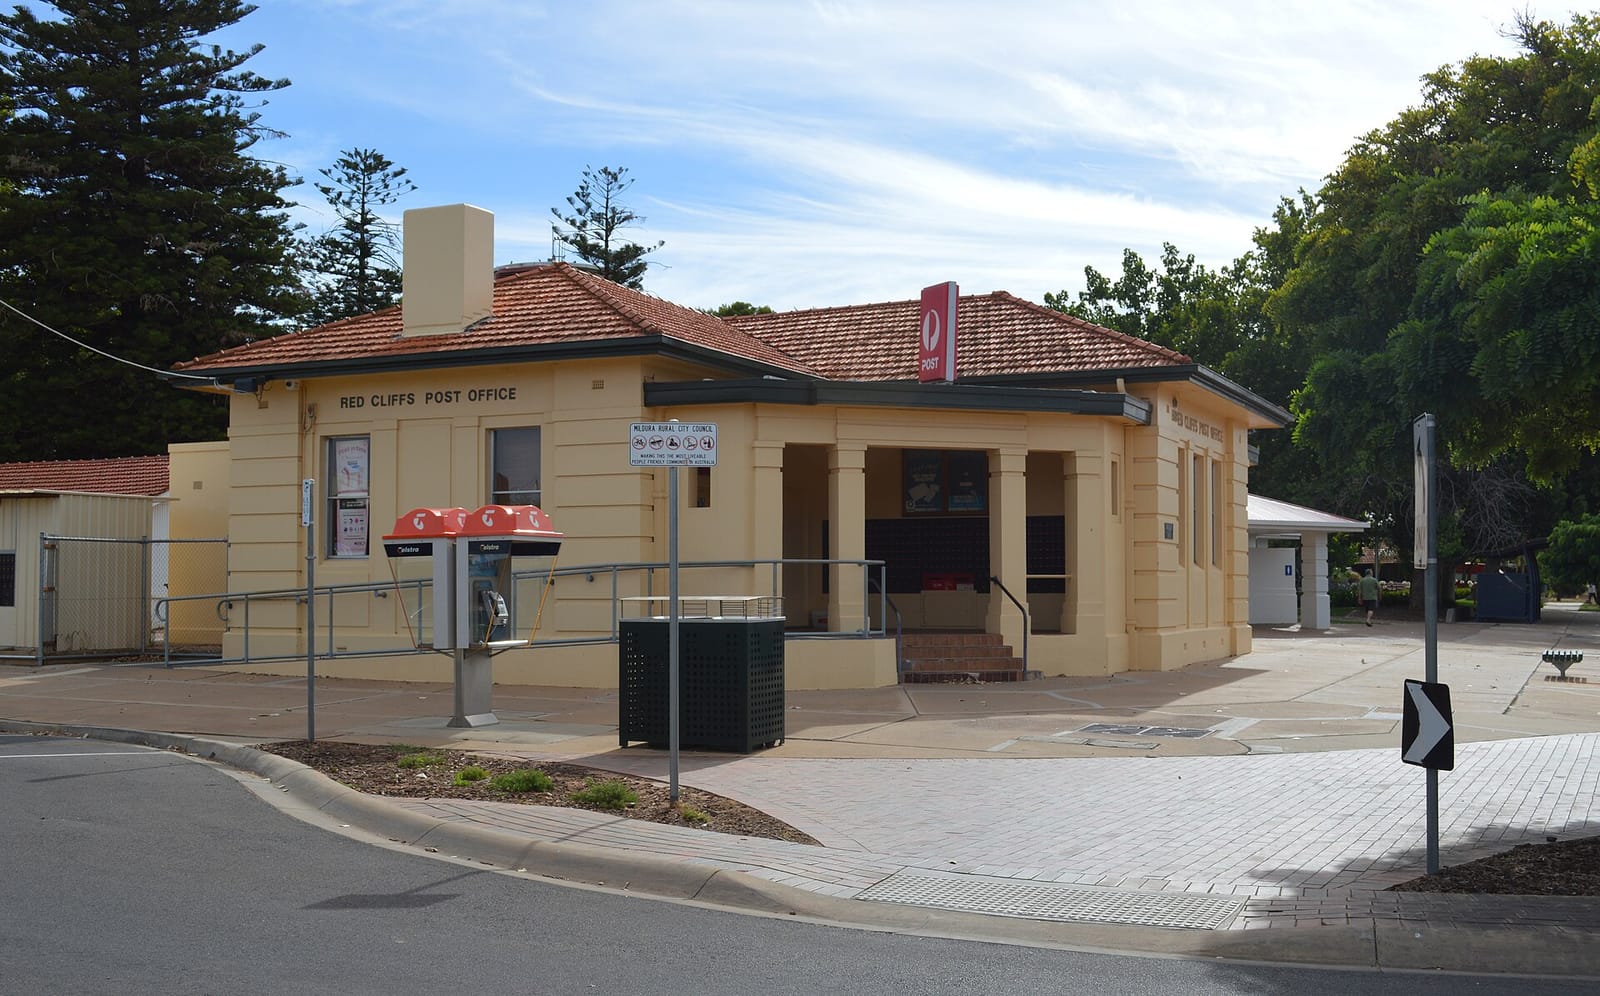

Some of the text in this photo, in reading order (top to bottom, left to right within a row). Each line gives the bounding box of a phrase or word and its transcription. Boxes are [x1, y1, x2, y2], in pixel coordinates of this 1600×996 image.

[921, 357, 939, 371] POST
[340, 387, 517, 409] RED CLIFFS POST OFFICE
[1184, 415, 1198, 433] CLIFFS
[1199, 422, 1210, 438] POST
[1210, 426, 1224, 443] OFFICE
